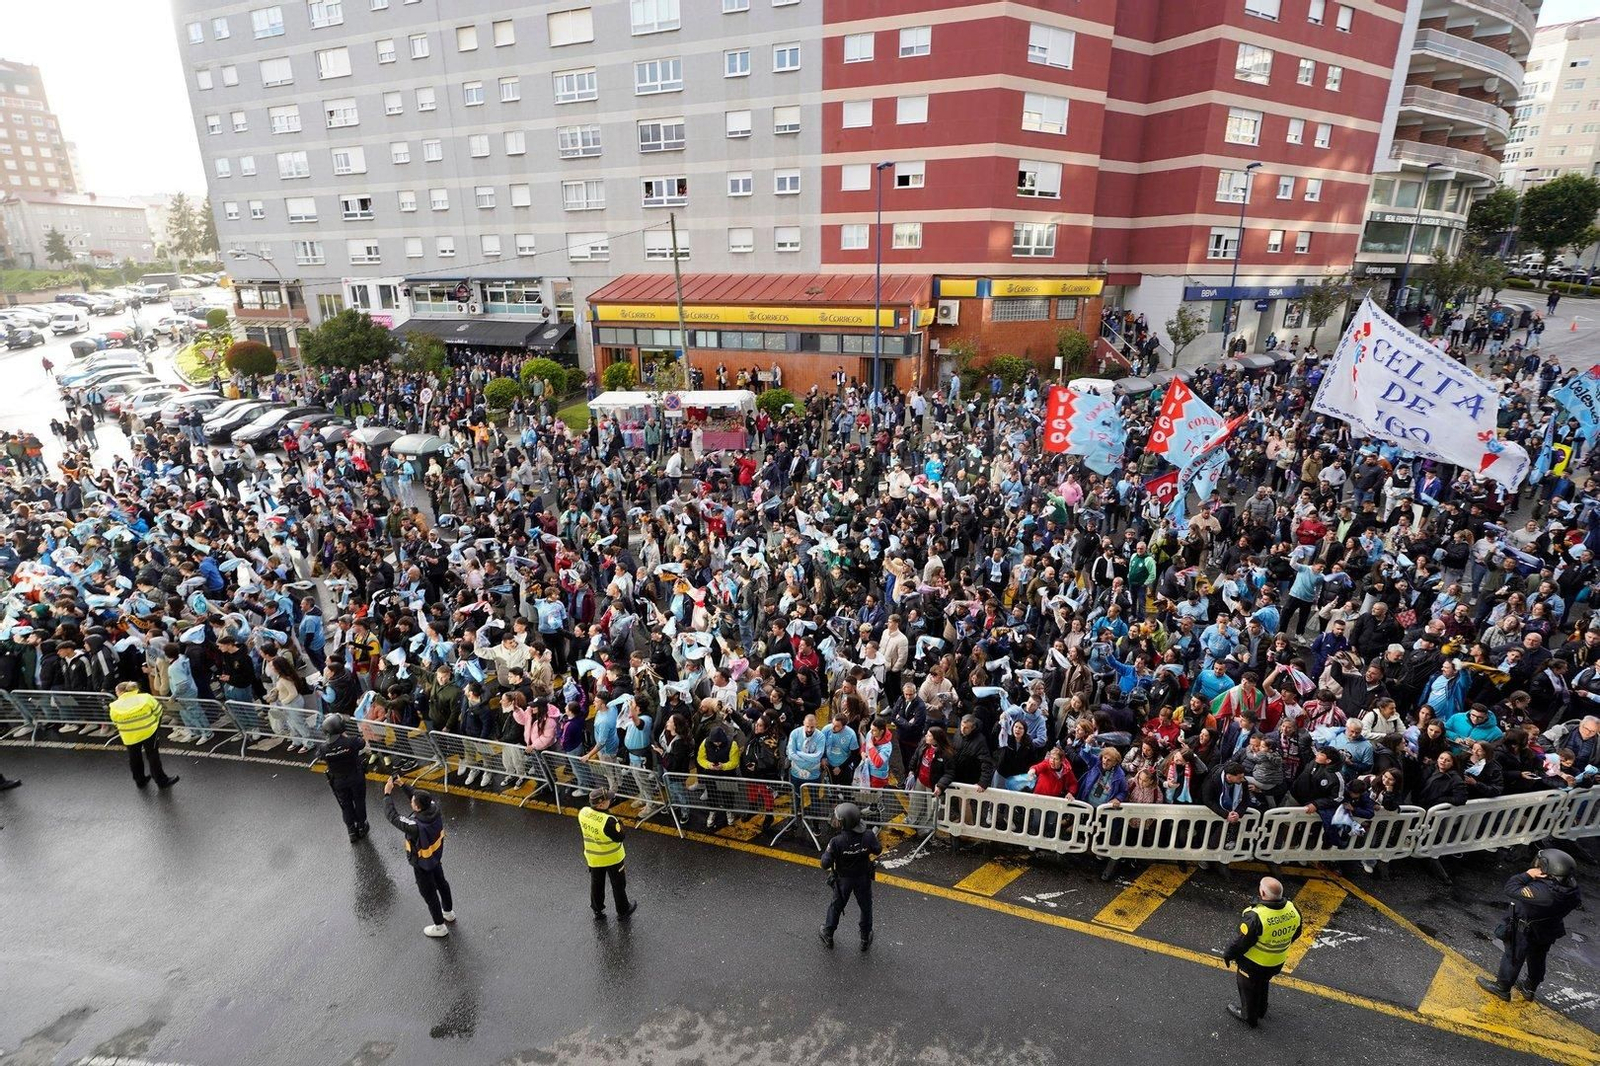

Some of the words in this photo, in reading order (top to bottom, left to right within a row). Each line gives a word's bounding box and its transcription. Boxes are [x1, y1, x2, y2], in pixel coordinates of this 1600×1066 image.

[1201, 288, 1218, 298] BBVA
[1268, 288, 1283, 297] BBVA
[627, 311, 656, 319] CORREOS
[690, 311, 720, 320] CORREOS
[757, 313, 789, 323] CORREOS
[828, 314, 862, 324] CORREOS
[1373, 338, 1485, 421] CELTA
[1380, 381, 1436, 416] DE
[1050, 390, 1071, 444] VIGO
[1153, 385, 1186, 443] VIGO
[1267, 910, 1296, 926] SEGURIDAD
